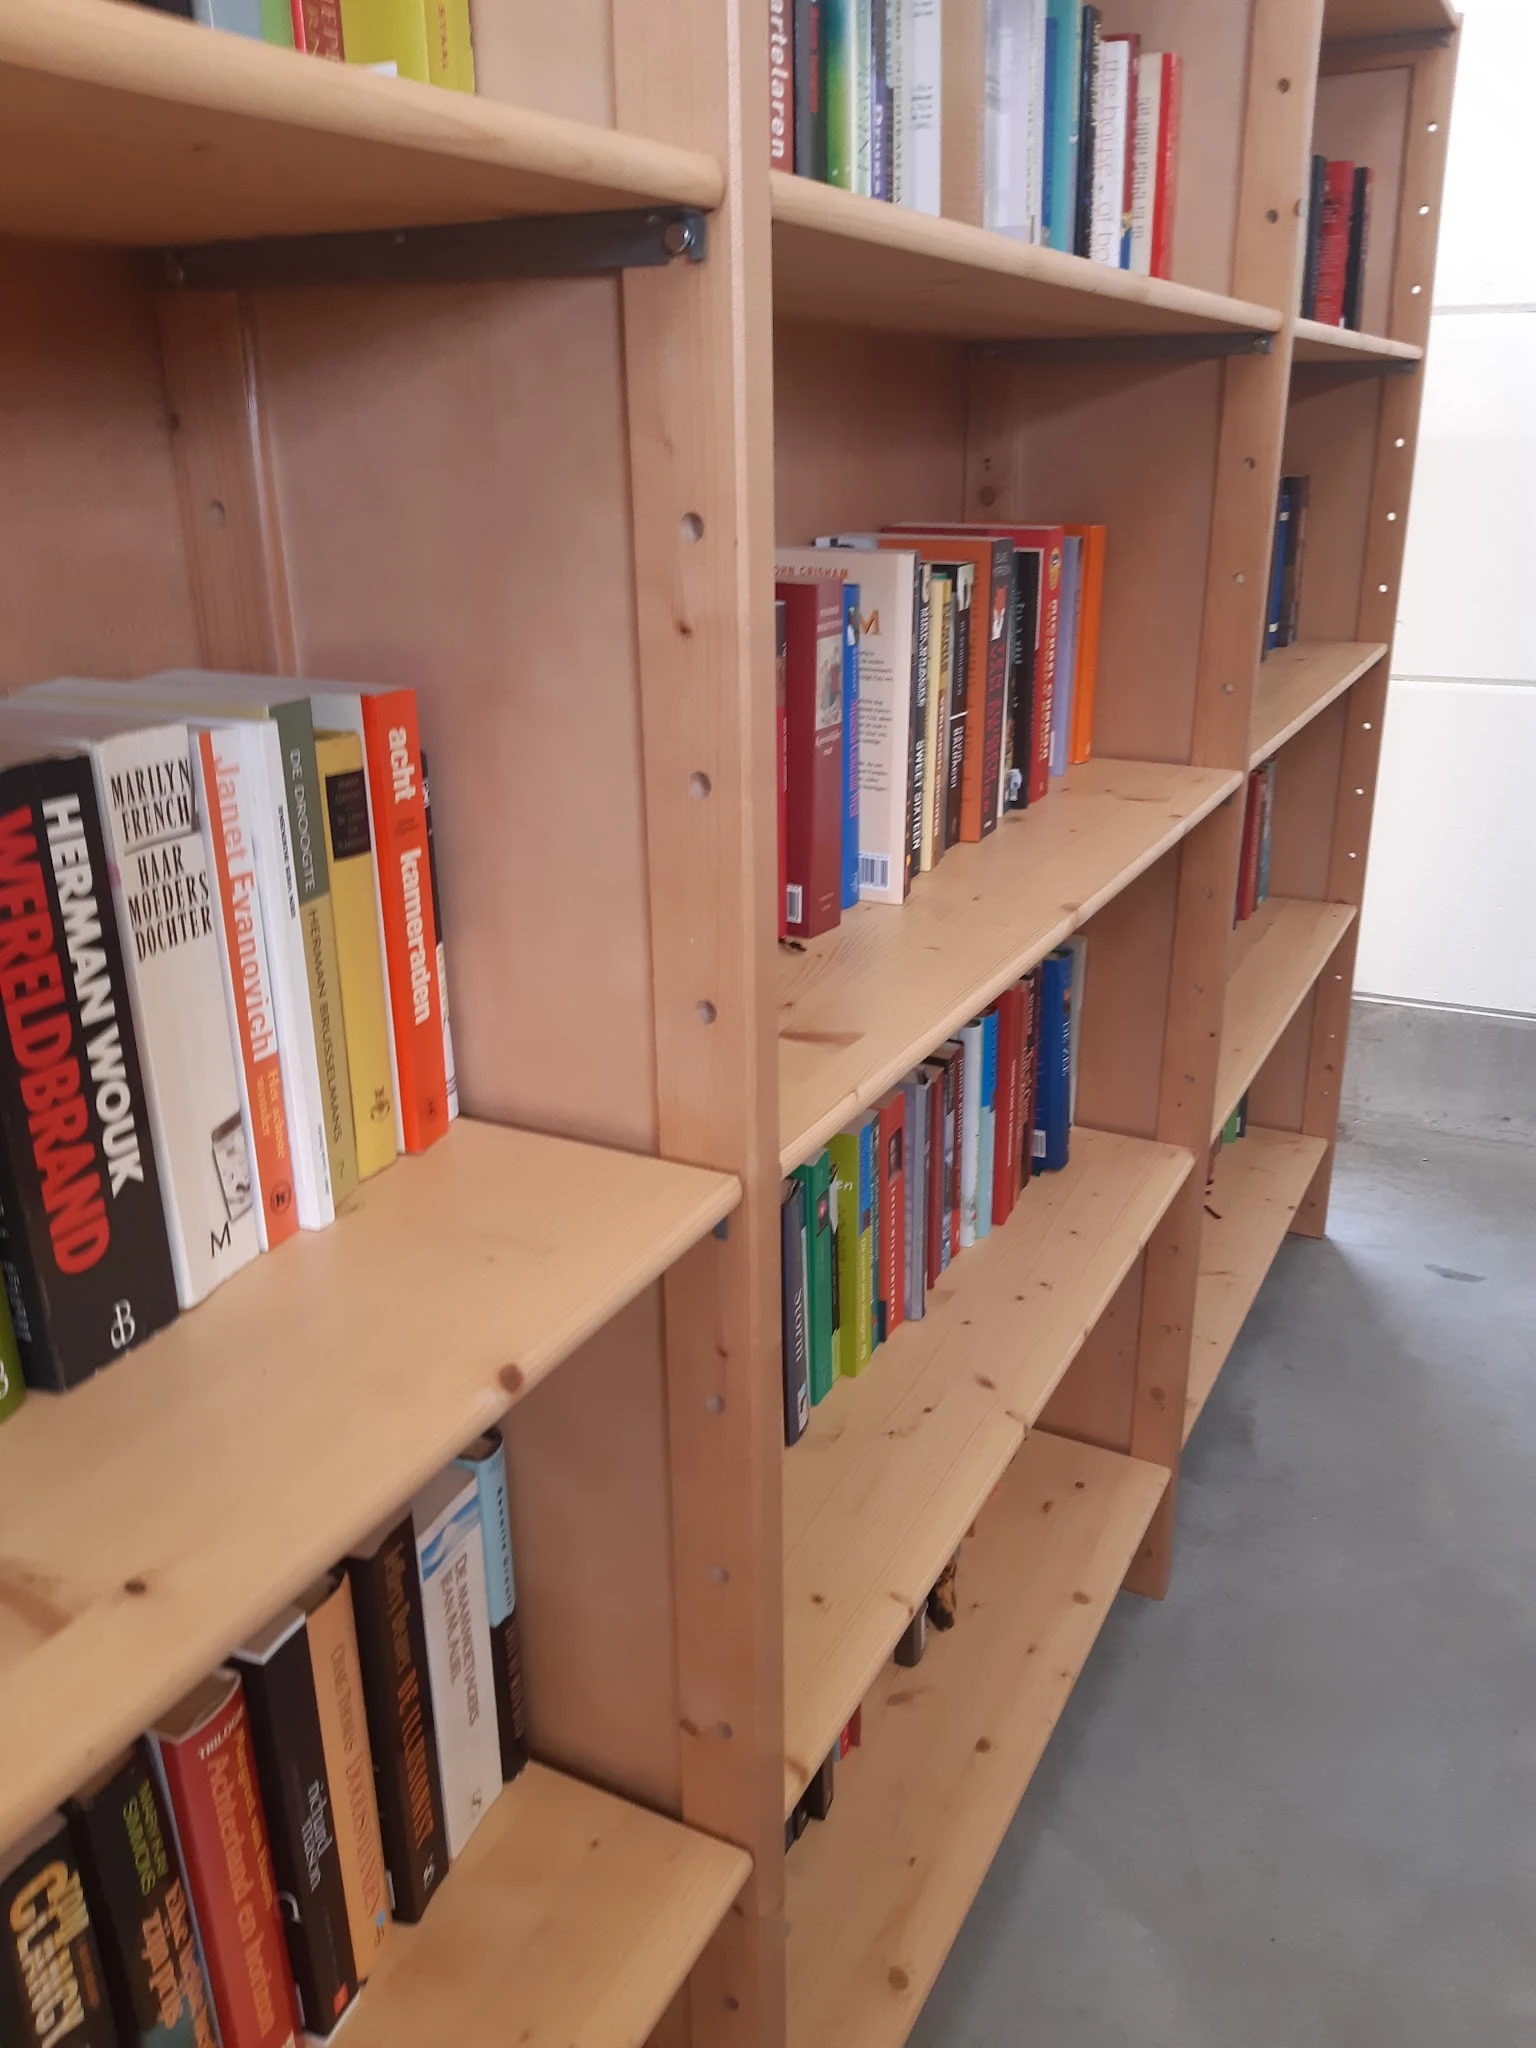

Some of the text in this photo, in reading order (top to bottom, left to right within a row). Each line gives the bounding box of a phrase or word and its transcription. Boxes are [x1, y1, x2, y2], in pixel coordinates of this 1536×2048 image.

[110, 757, 192, 811] MARILYN
[388, 725, 416, 805] acht
[912, 740, 925, 851] SWEET SIXTEEN
[121, 795, 191, 844] FRENCH
[289, 749, 316, 893] DE DROOGTE
[127, 872, 210, 931] MOEDERS
[136, 844, 185, 888] HAAR
[134, 905, 213, 963] DOCHTER
[213, 756, 278, 1063] Janet Evanovich
[399, 848, 431, 1026] kameraden
[41, 793, 144, 1198] HERMAN WOUK
[308, 908, 328, 1000] HERMAN
[318, 1004, 343, 1144] BRUSSELMANS
[0, 805, 110, 1275] WERELDBRAND
[793, 1286, 804, 1363] Storm
[439, 1571, 457, 1622] JEAN
[452, 1551, 468, 1585] DE
[397, 1664, 436, 1847] DE ILLUSIONIST
[207, 1752, 253, 1906] Achterland
[244, 1901, 262, 1941] en
[306, 1779, 334, 1855] richard
[300, 1823, 323, 1893] mason
[10, 1859, 85, 2044] CLANCY
